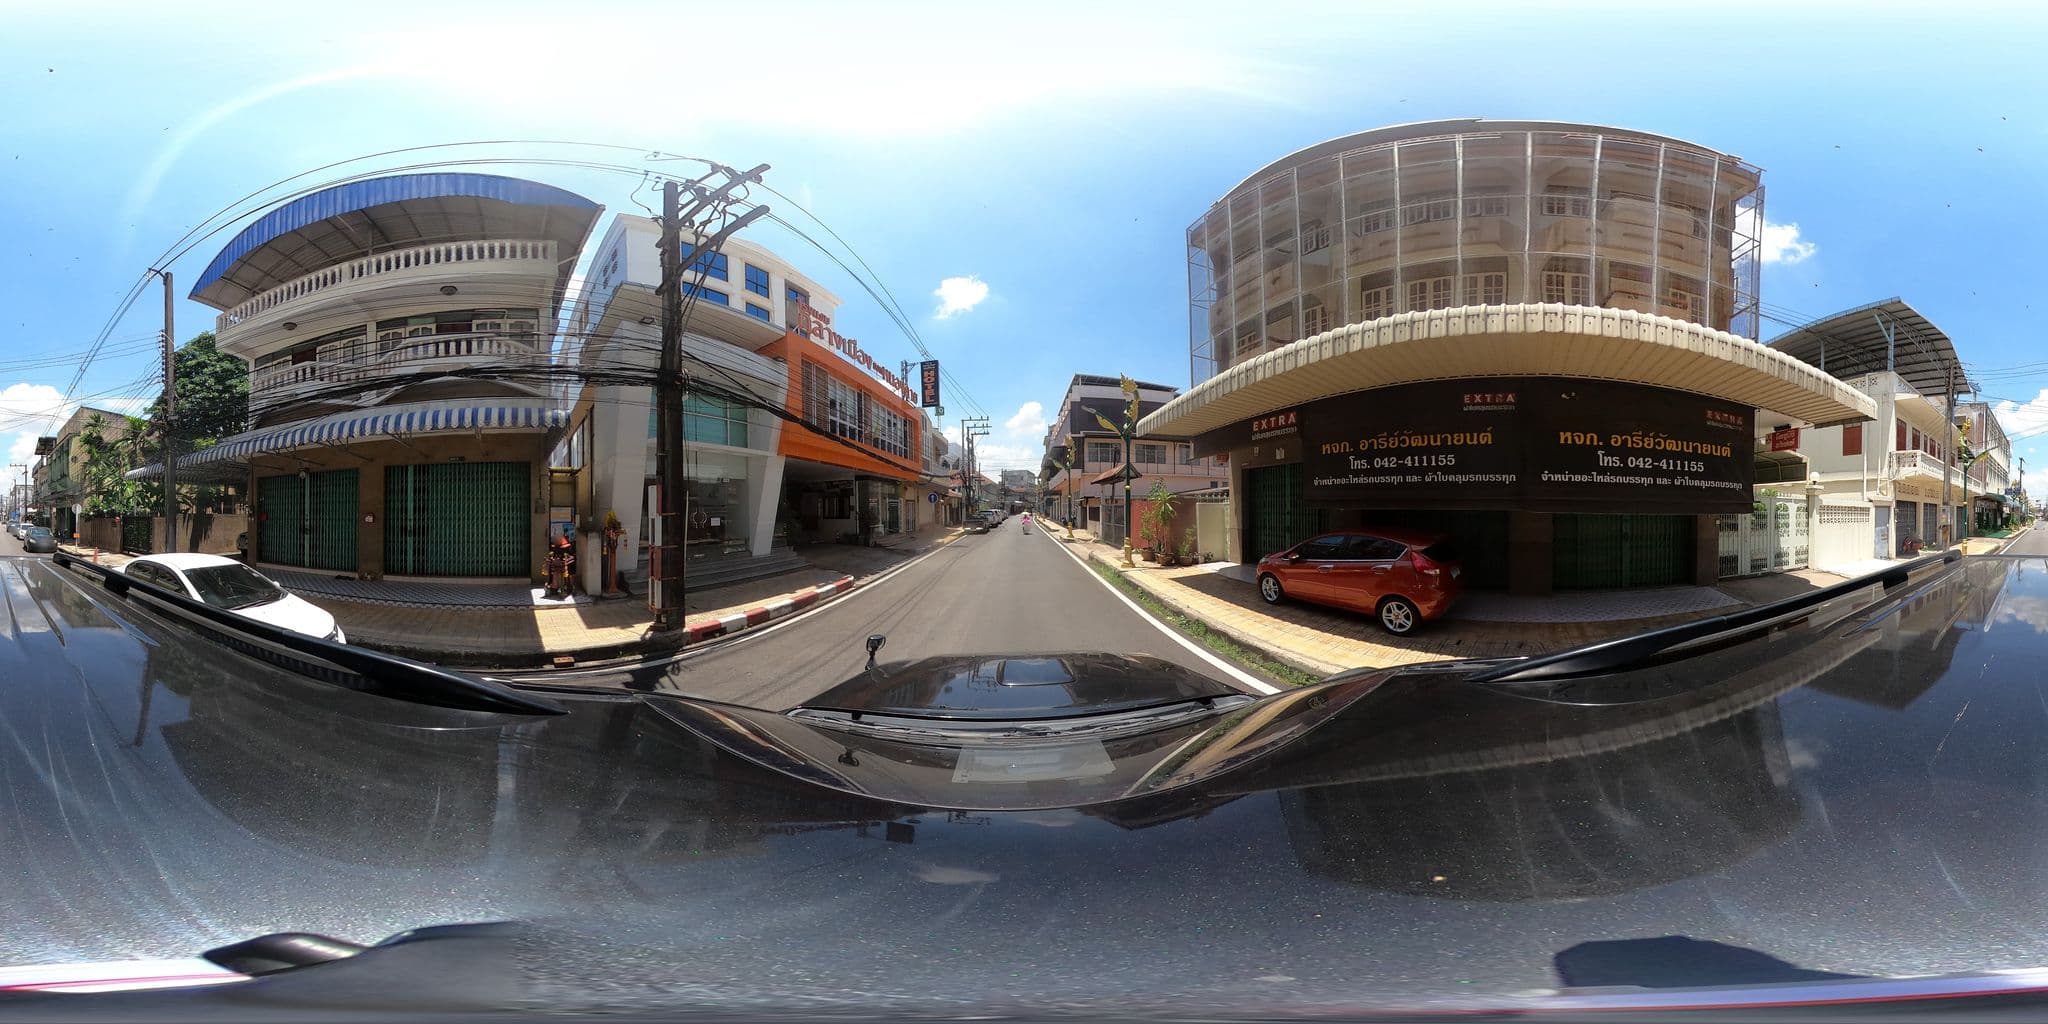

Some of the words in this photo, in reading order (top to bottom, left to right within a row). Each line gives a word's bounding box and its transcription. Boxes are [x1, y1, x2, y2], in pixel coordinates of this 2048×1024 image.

[799, 309, 873, 370] กลางเมือง
[923, 370, 936, 403] HOTEL
[1464, 394, 1515, 403] EXTRA
[1253, 412, 1297, 431] EXTRA
[1322, 440, 1354, 455] หจก.
[1359, 426, 1493, 451] อารีย์วัฒนายนต์
[1559, 431, 1604, 446] หจก.
[1610, 431, 1732, 458] อารีย์วัฒนายนต์
[1349, 456, 1371, 470] โทร.
[1374, 454, 1456, 469] 042-411155
[1598, 451, 1624, 467] โทร.
[1627, 456, 1705, 472] 042-411155
[1313, 474, 1403, 486] จำหน่ายอะไหล่รถบรรทุก
[1405, 474, 1422, 483] และ
[1424, 471, 1516, 484] ผ้าใบคลุมรถบรรทุก
[1541, 471, 1653, 487] จำหน่ายอะไหล่รถบรรทุก
[1656, 476, 1671, 485] และ
[1674, 476, 1743, 490] ผ้าใบคลุมรถบรรทุก
